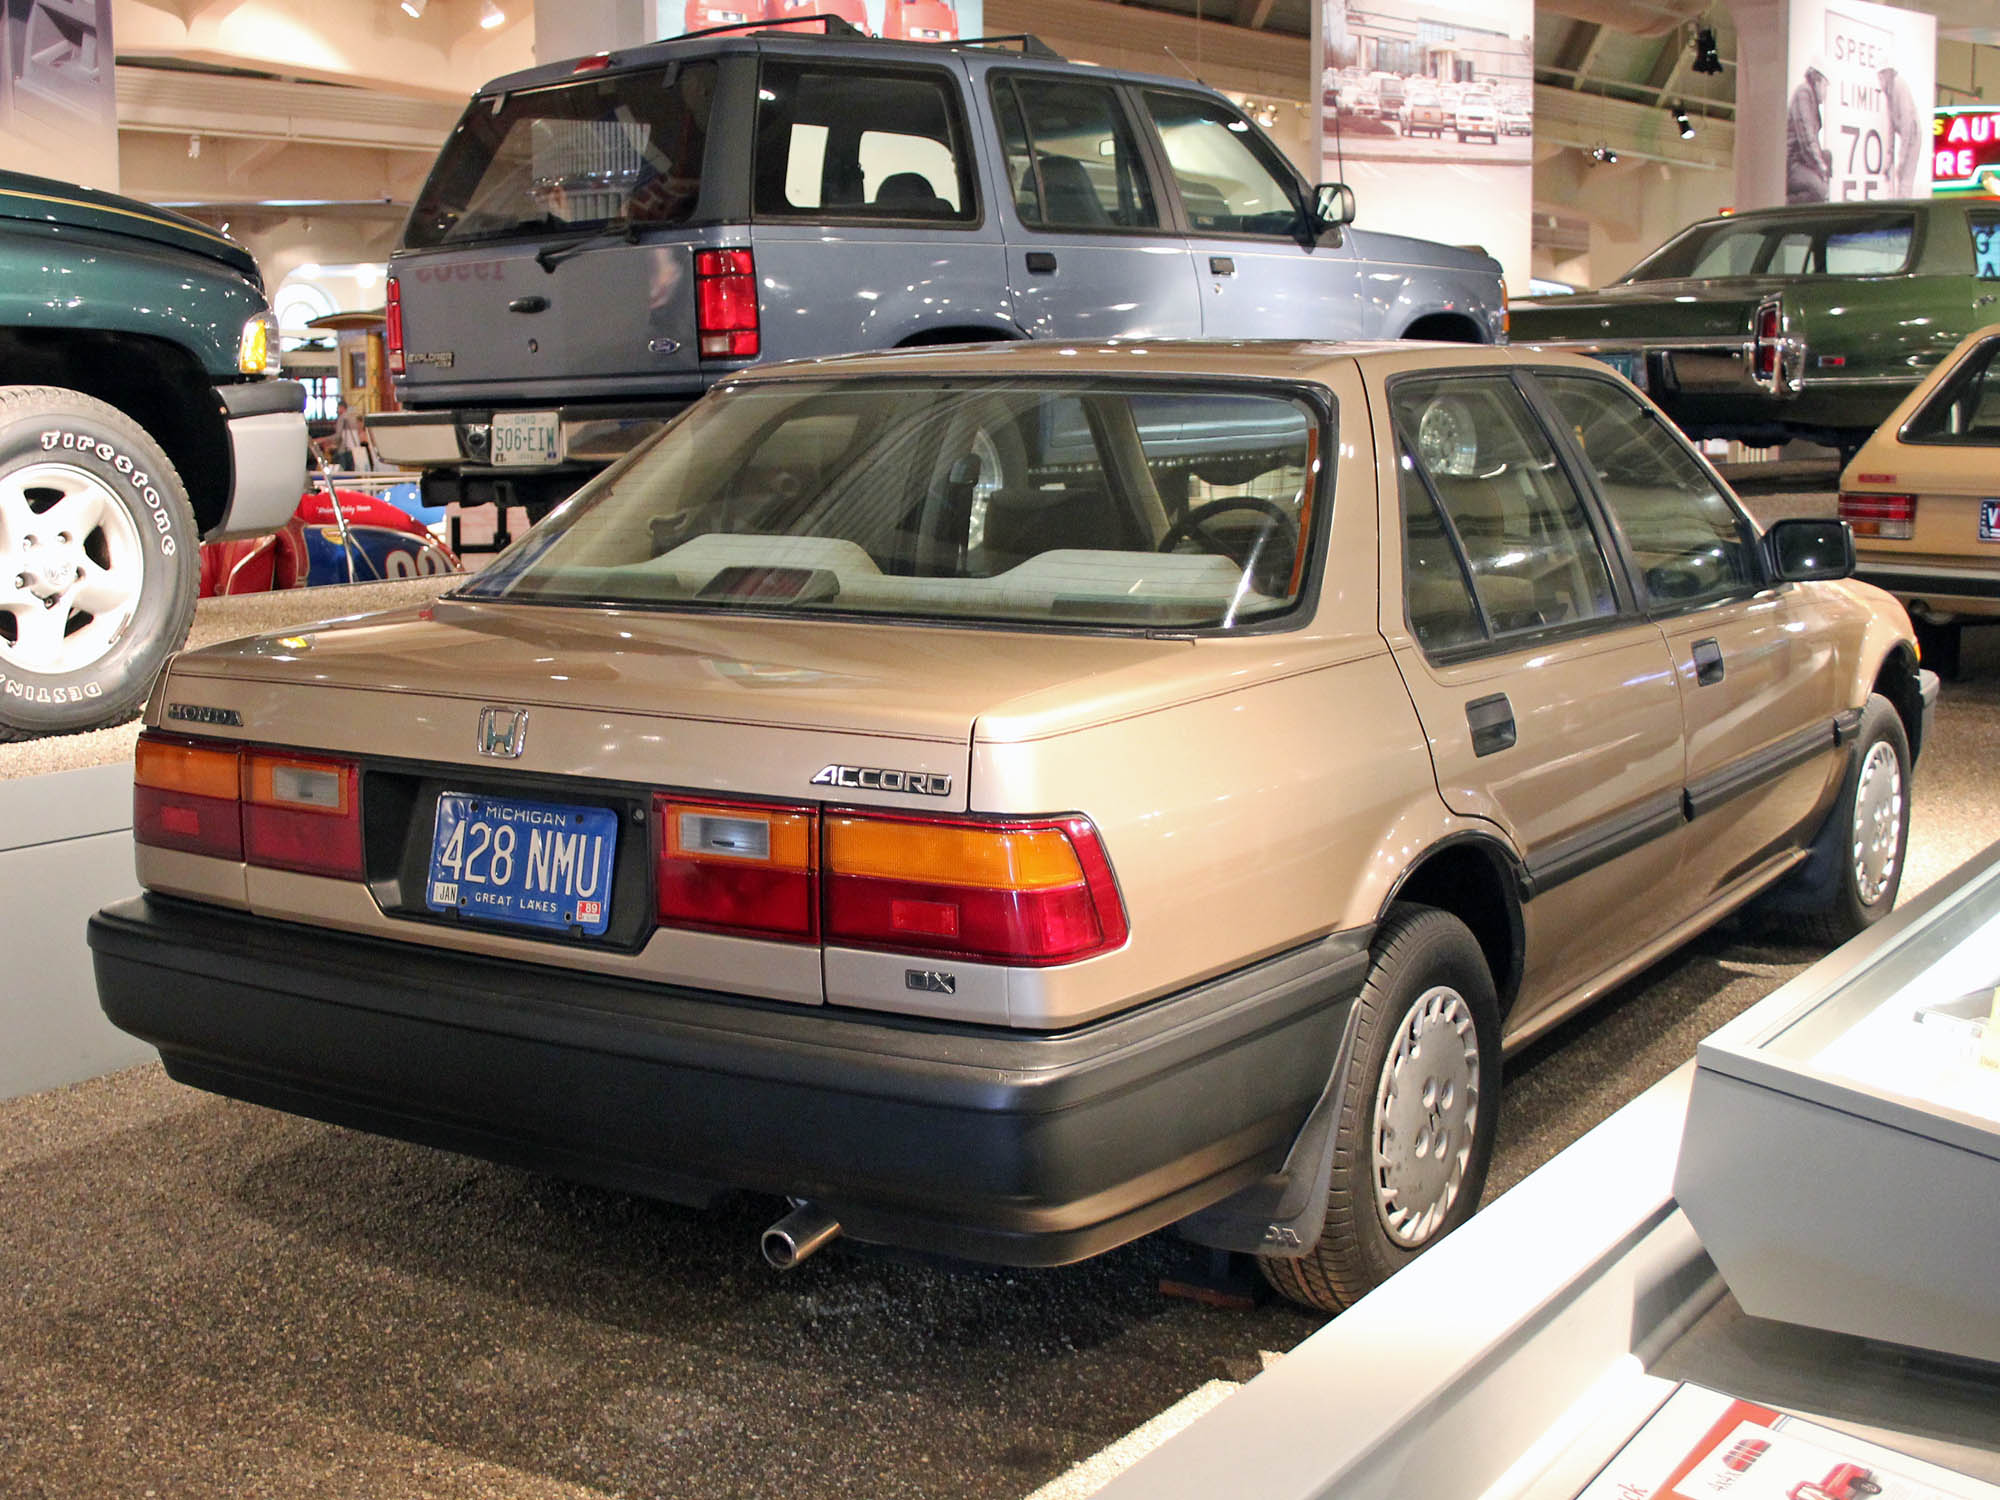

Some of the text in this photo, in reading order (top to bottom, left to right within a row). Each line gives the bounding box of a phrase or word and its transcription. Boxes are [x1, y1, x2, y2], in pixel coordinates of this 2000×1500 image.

[1835, 34, 1881, 69] SPEE
[1840, 80, 1883, 113] LIMIT
[1840, 125, 1883, 175] 70
[41, 430, 176, 556] Firestone
[168, 703, 244, 727] HONDA
[810, 764, 953, 797] ACCORD
[485, 806, 567, 827] MICHIGAN
[441, 820, 602, 898] 428 NMU
[440, 885, 456, 901] JAN
[475, 892, 558, 913] GREAT LAKES
[585, 903, 598, 914] 89
[905, 969, 956, 994] DX
